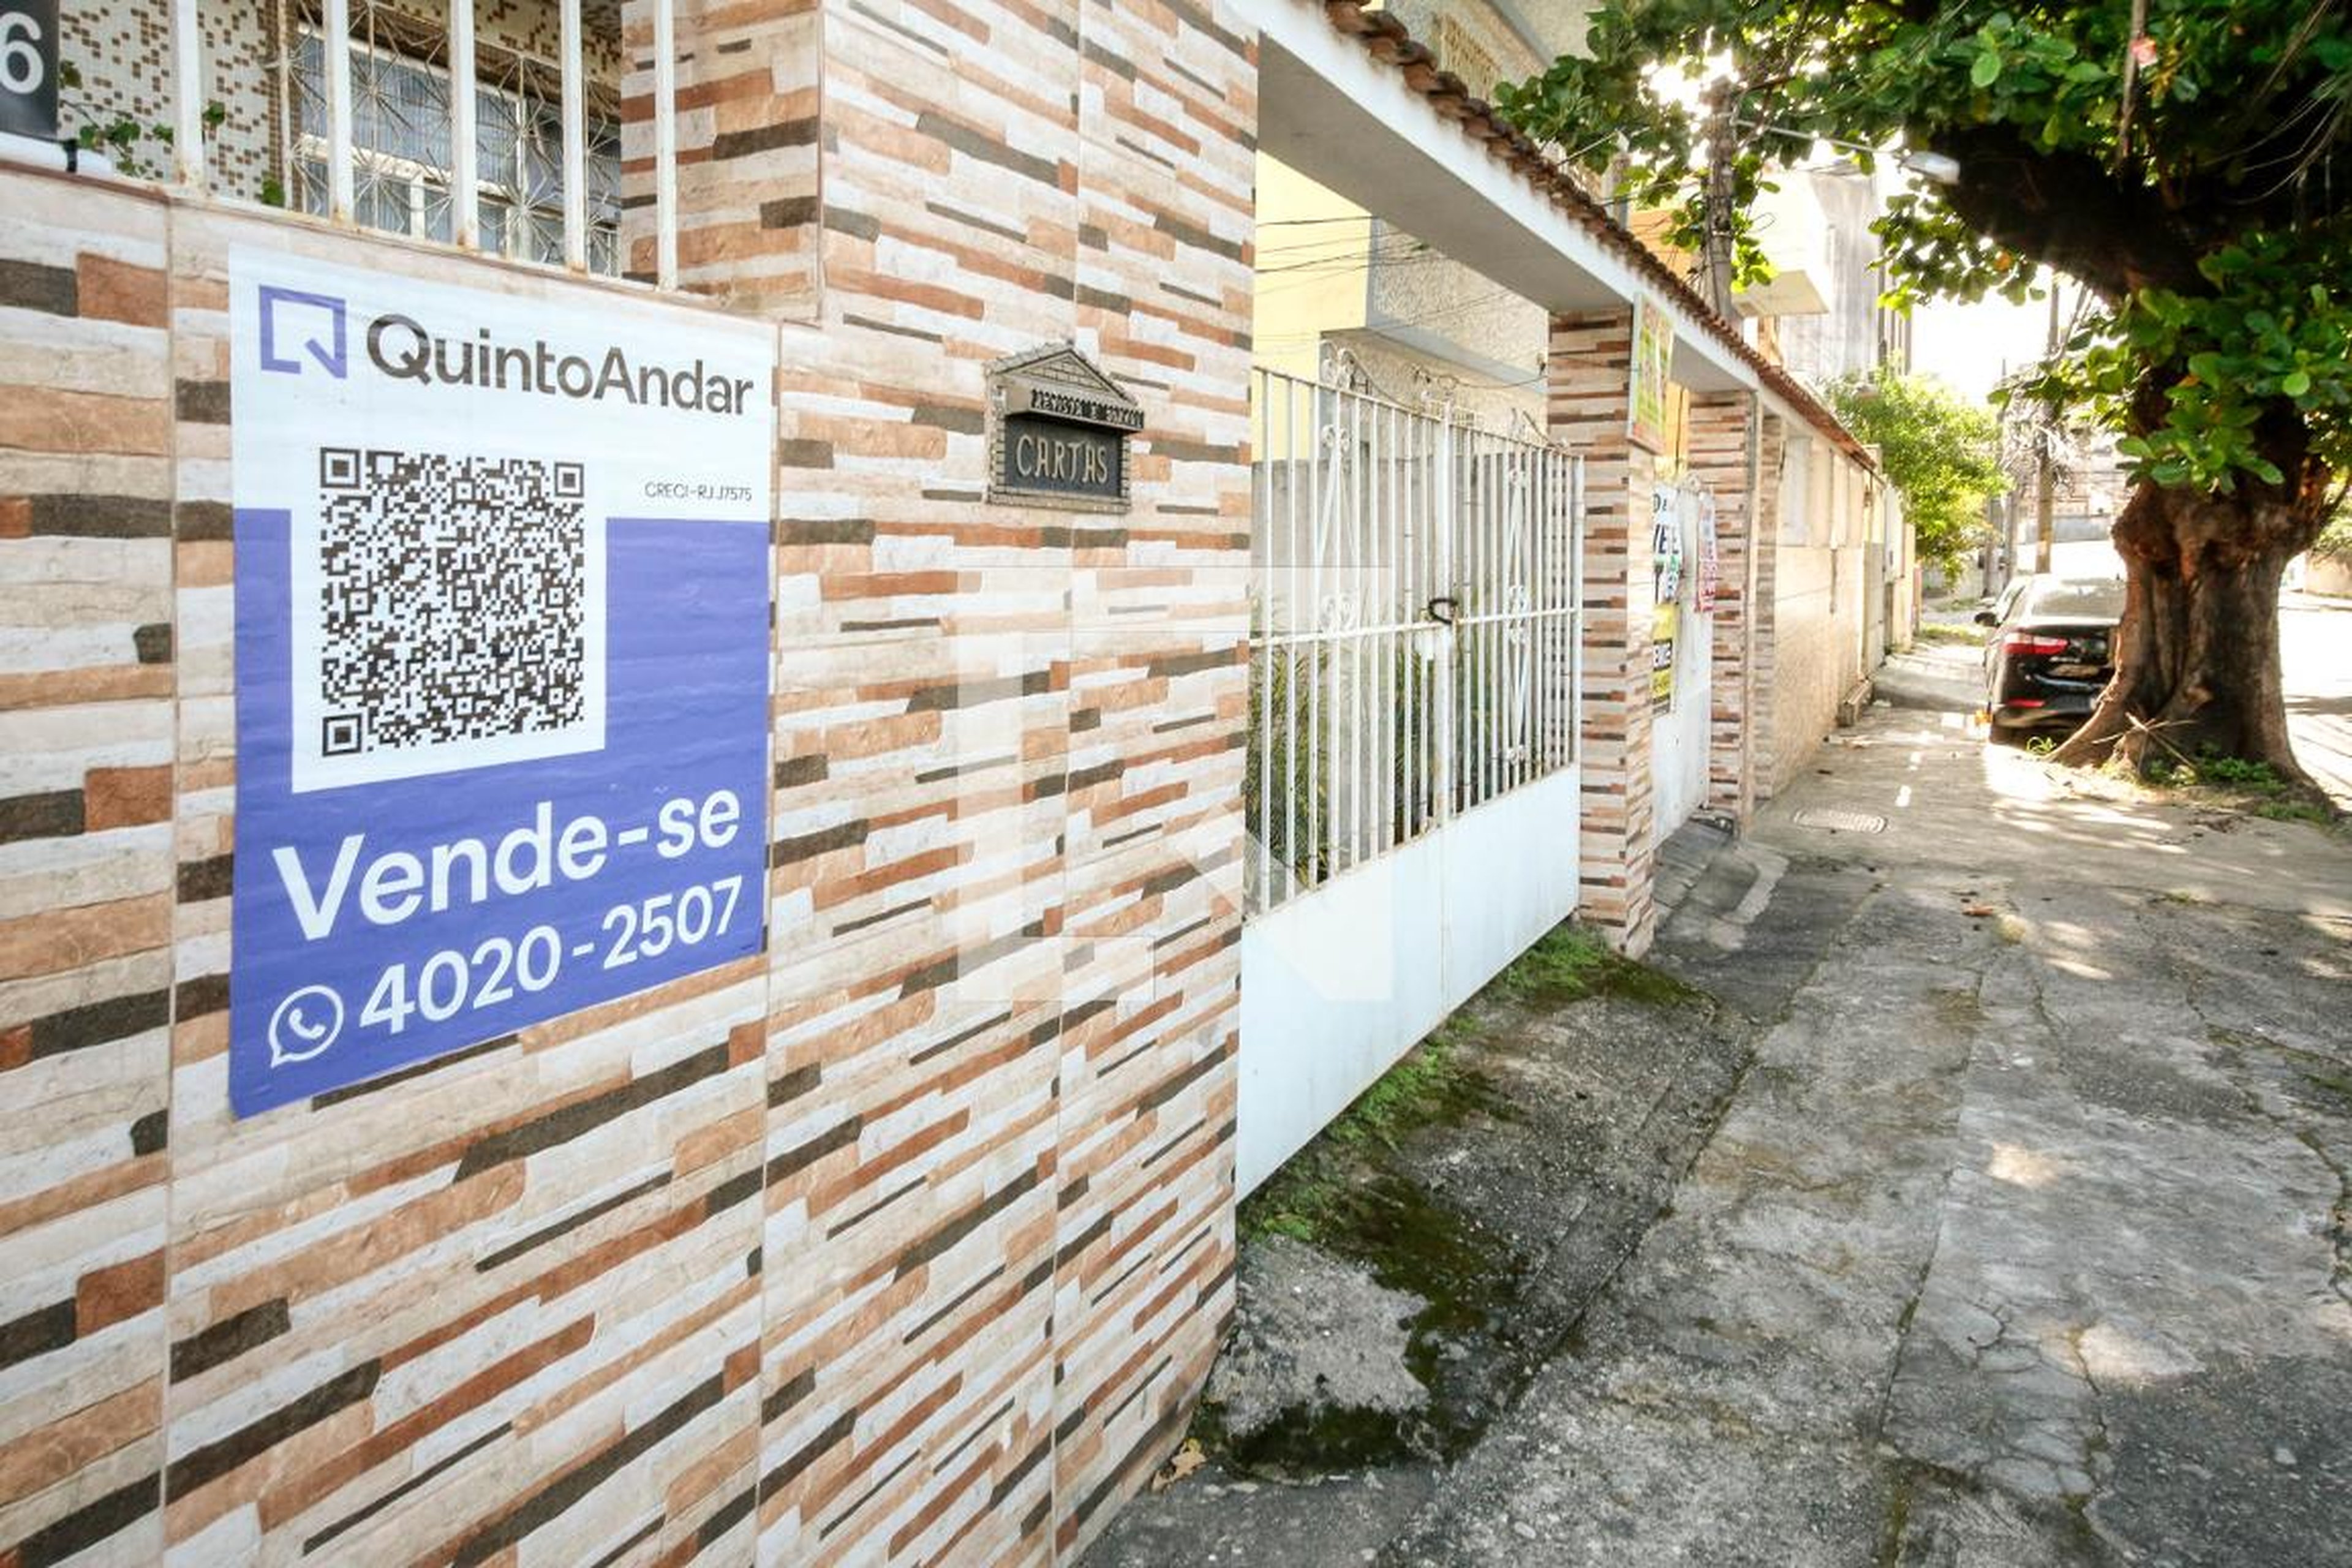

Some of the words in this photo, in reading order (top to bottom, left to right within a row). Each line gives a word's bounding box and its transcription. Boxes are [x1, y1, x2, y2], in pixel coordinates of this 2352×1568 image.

[0, 12, 43, 94] 6
[367, 313, 754, 415] QuintoAndar
[1016, 434, 1108, 484] CARTAS
[273, 789, 740, 941] Vende-se
[359, 875, 742, 1034] 4020-2507
